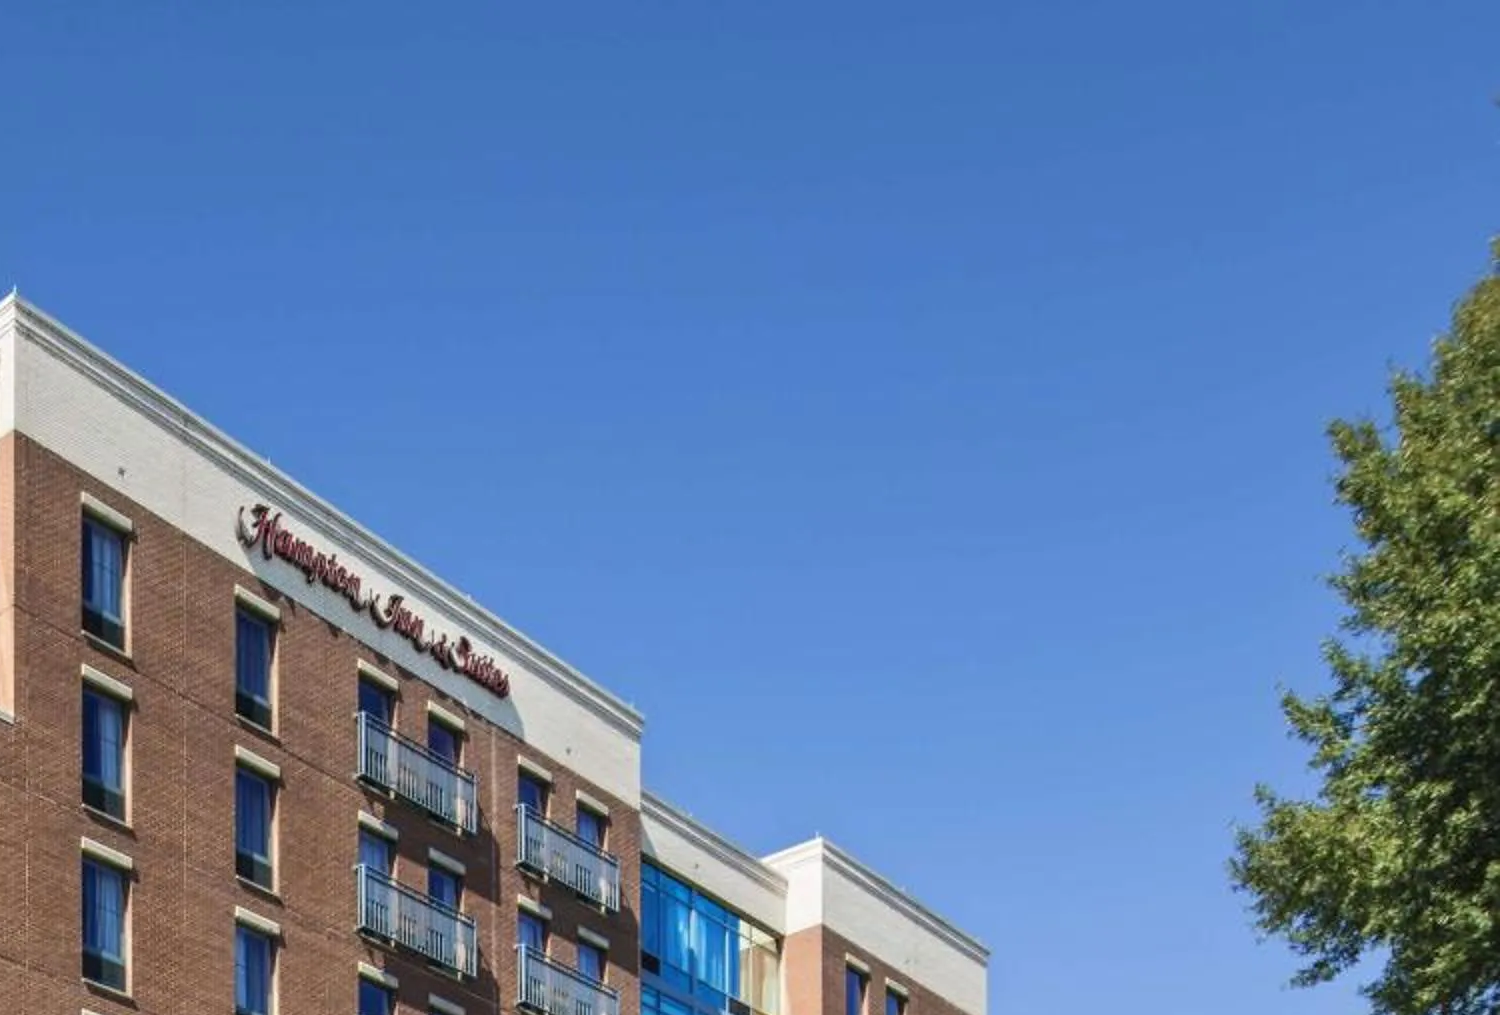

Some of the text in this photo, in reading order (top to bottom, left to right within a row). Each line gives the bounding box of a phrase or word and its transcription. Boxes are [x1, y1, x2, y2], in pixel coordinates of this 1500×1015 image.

[235, 503, 370, 612] Hampton
[368, 593, 434, 652] Inn
[448, 636, 511, 699] Suites
